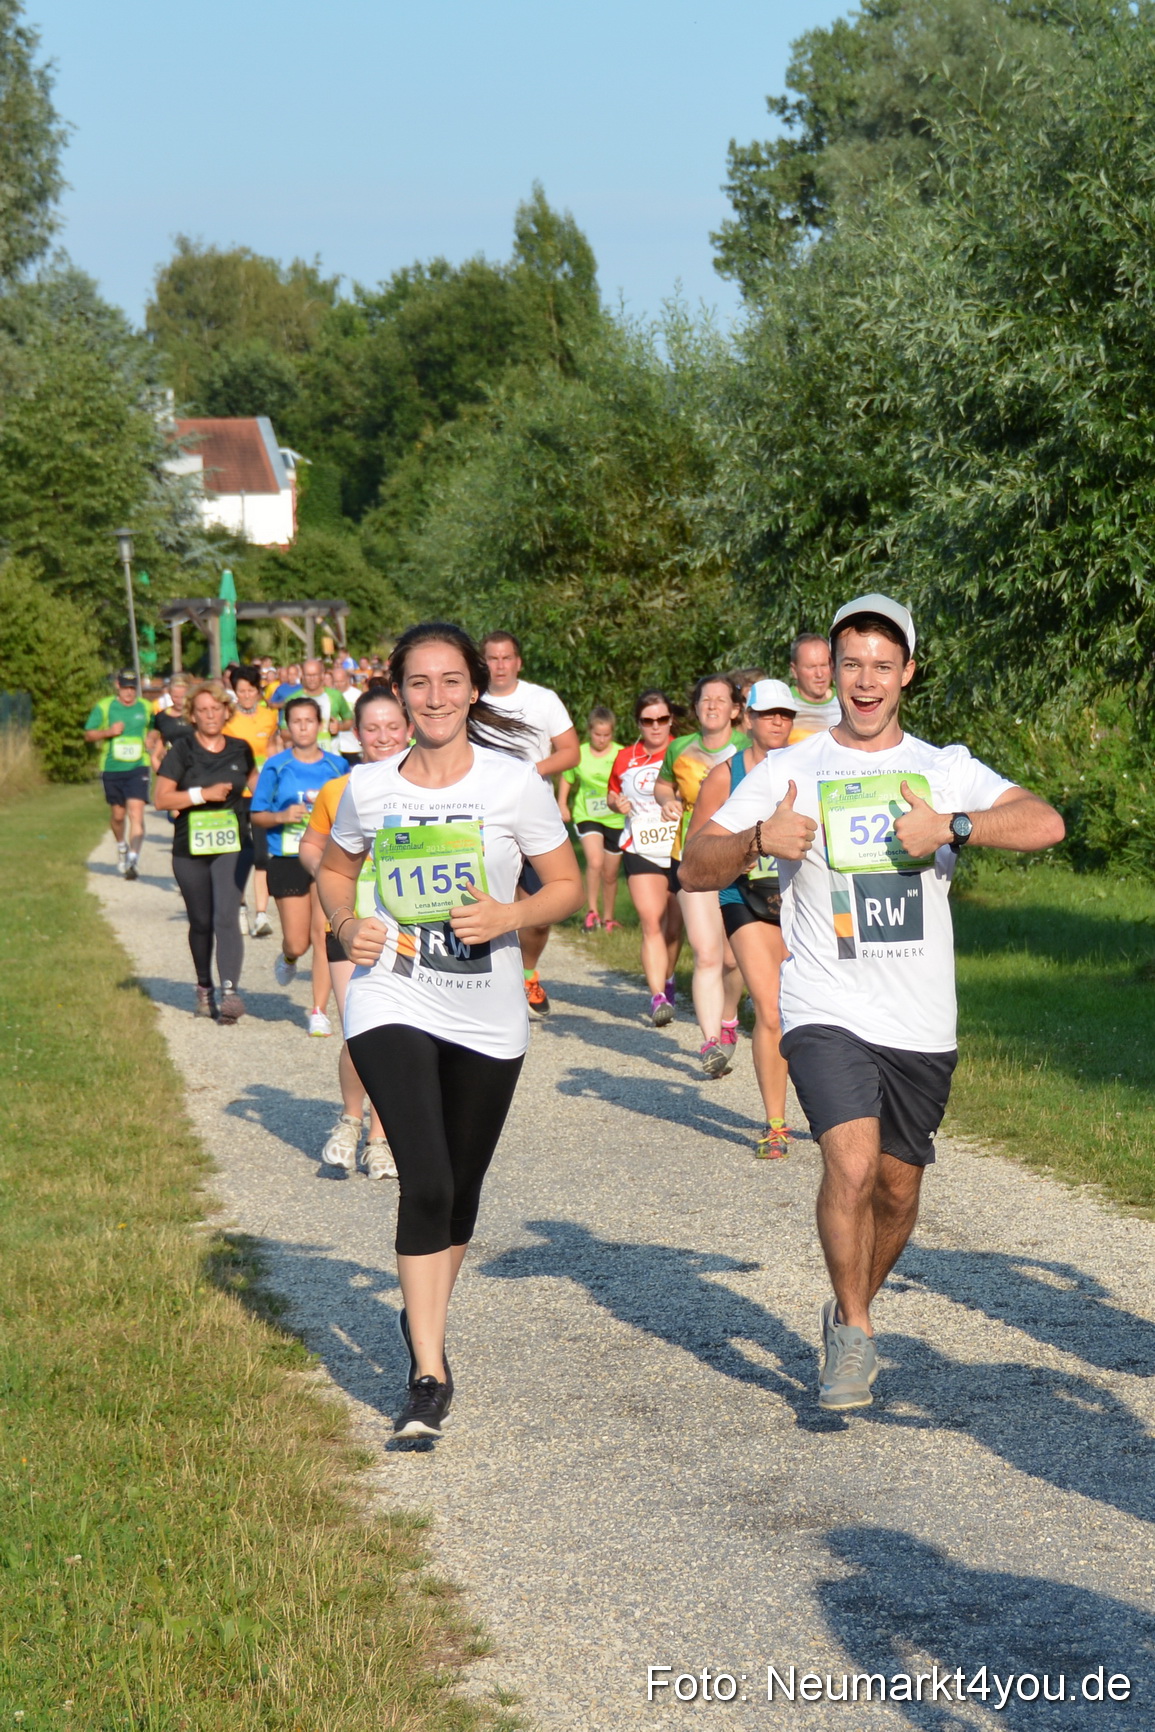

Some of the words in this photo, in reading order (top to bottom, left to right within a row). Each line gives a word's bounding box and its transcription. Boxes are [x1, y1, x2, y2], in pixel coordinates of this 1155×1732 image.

[383, 802, 398, 810] DIE
[402, 803, 425, 811] NEUE
[429, 802, 486, 811] WOHNFORMEL
[194, 829, 236, 848] 5189
[639, 825, 677, 845] 8925
[850, 813, 901, 846] 52
[425, 844, 446, 853] 2015
[858, 851, 877, 859] Leroy
[388, 862, 475, 897] 1155
[431, 900, 454, 908] Mantel
[865, 897, 905, 927] RW
[907, 888, 919, 897] NM
[429, 930, 471, 958] RW
[862, 947, 925, 959] RAUMWERK
[417, 973, 492, 990] RAUMWERK
